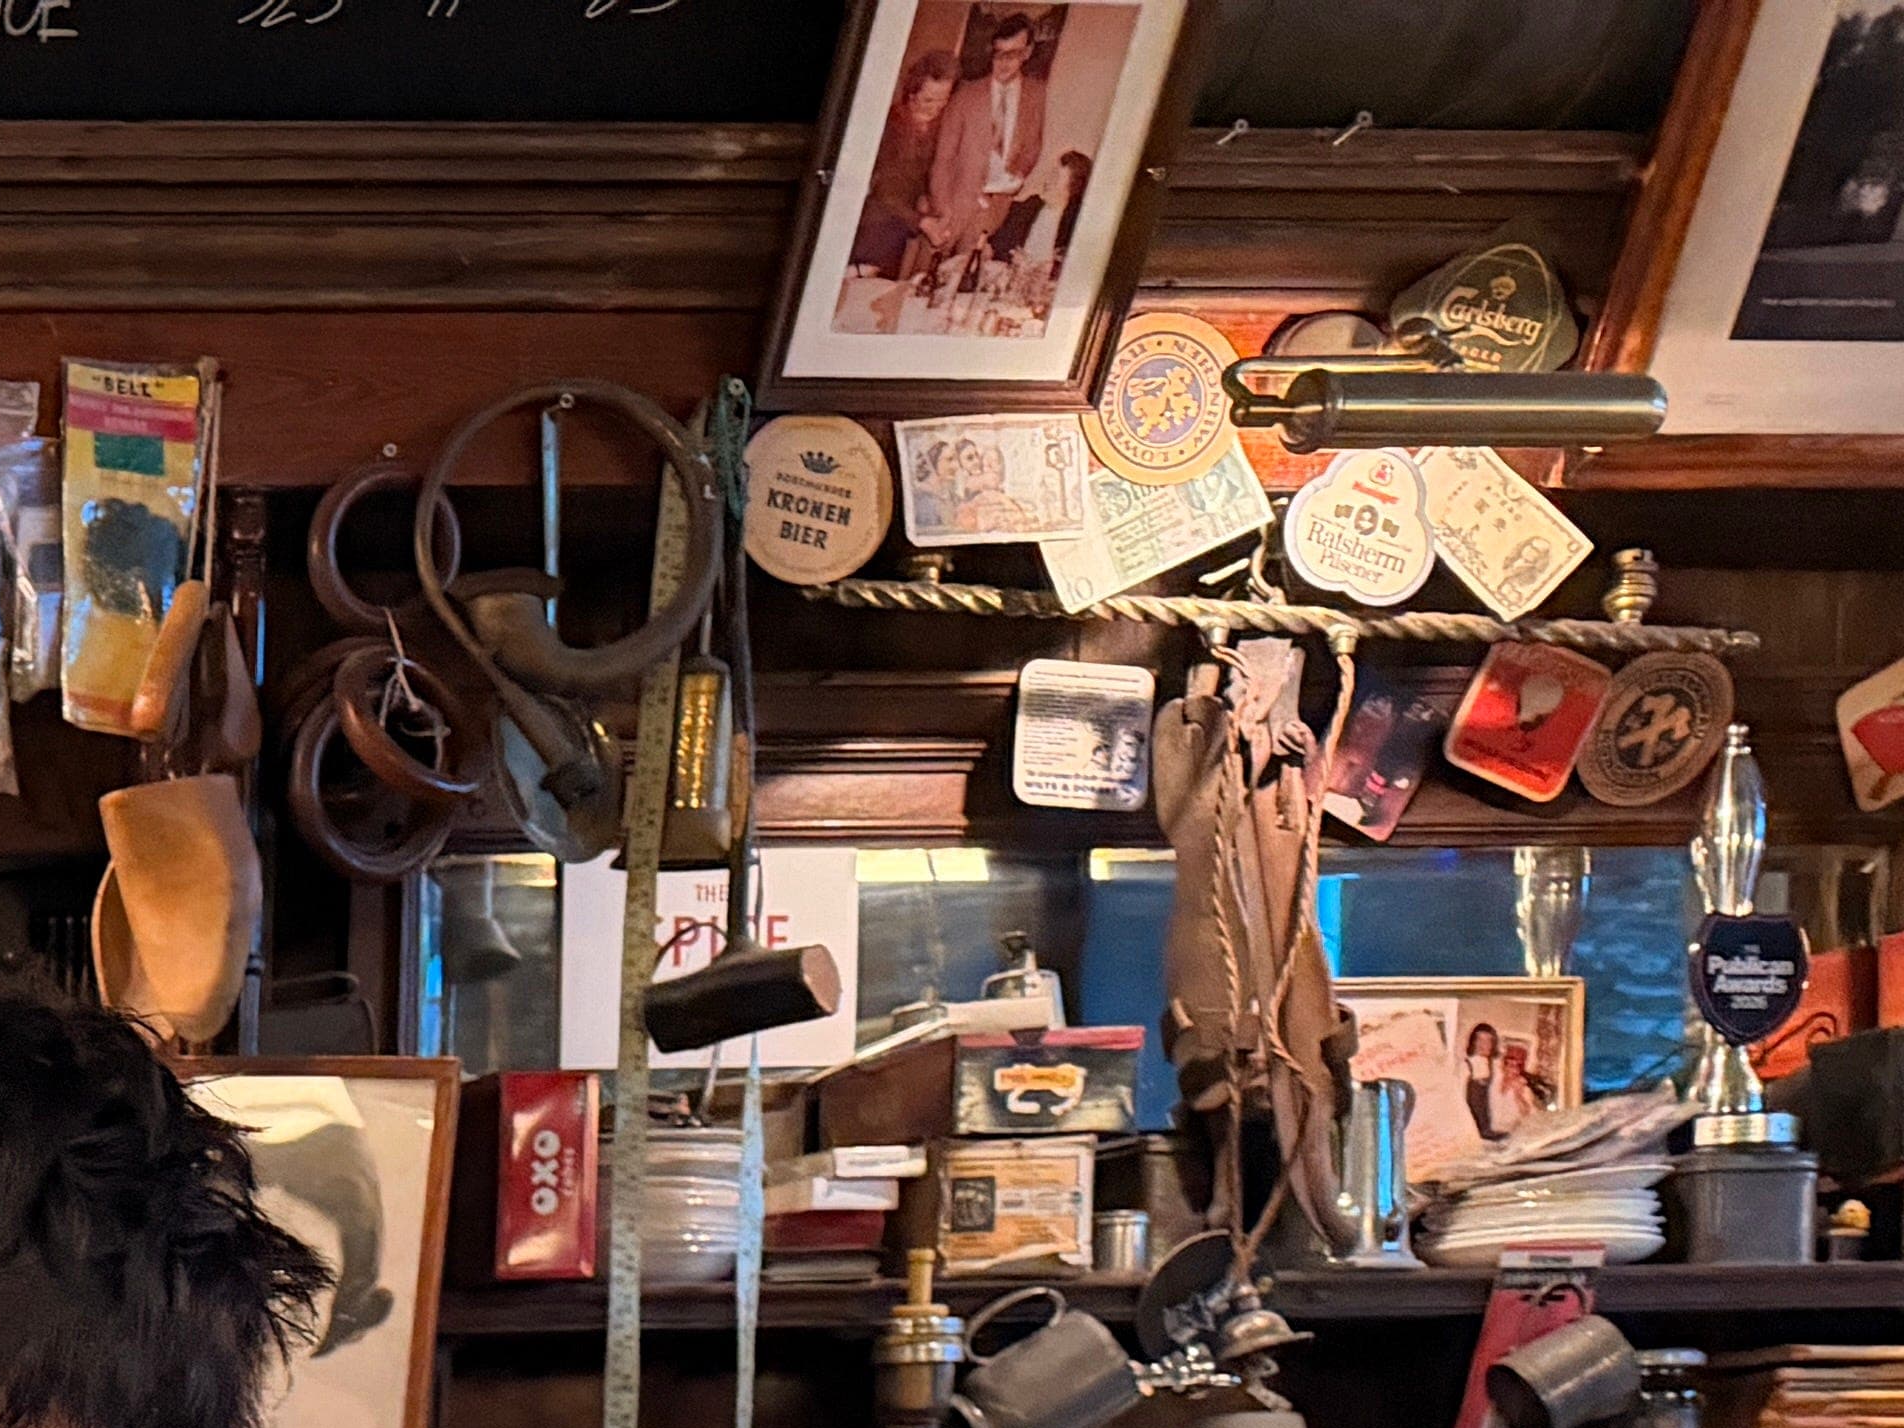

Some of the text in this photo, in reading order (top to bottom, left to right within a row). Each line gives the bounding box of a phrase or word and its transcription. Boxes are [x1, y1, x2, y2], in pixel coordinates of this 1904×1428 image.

[1442, 286, 1544, 346] Carlsberg
[767, 488, 852, 526] KRONEN
[780, 521, 828, 549] BIER
[695, 884, 730, 902] THE
[1708, 955, 1795, 975] Publican
[1713, 975, 1788, 994] Awards
[531, 1130, 562, 1215] OXO
